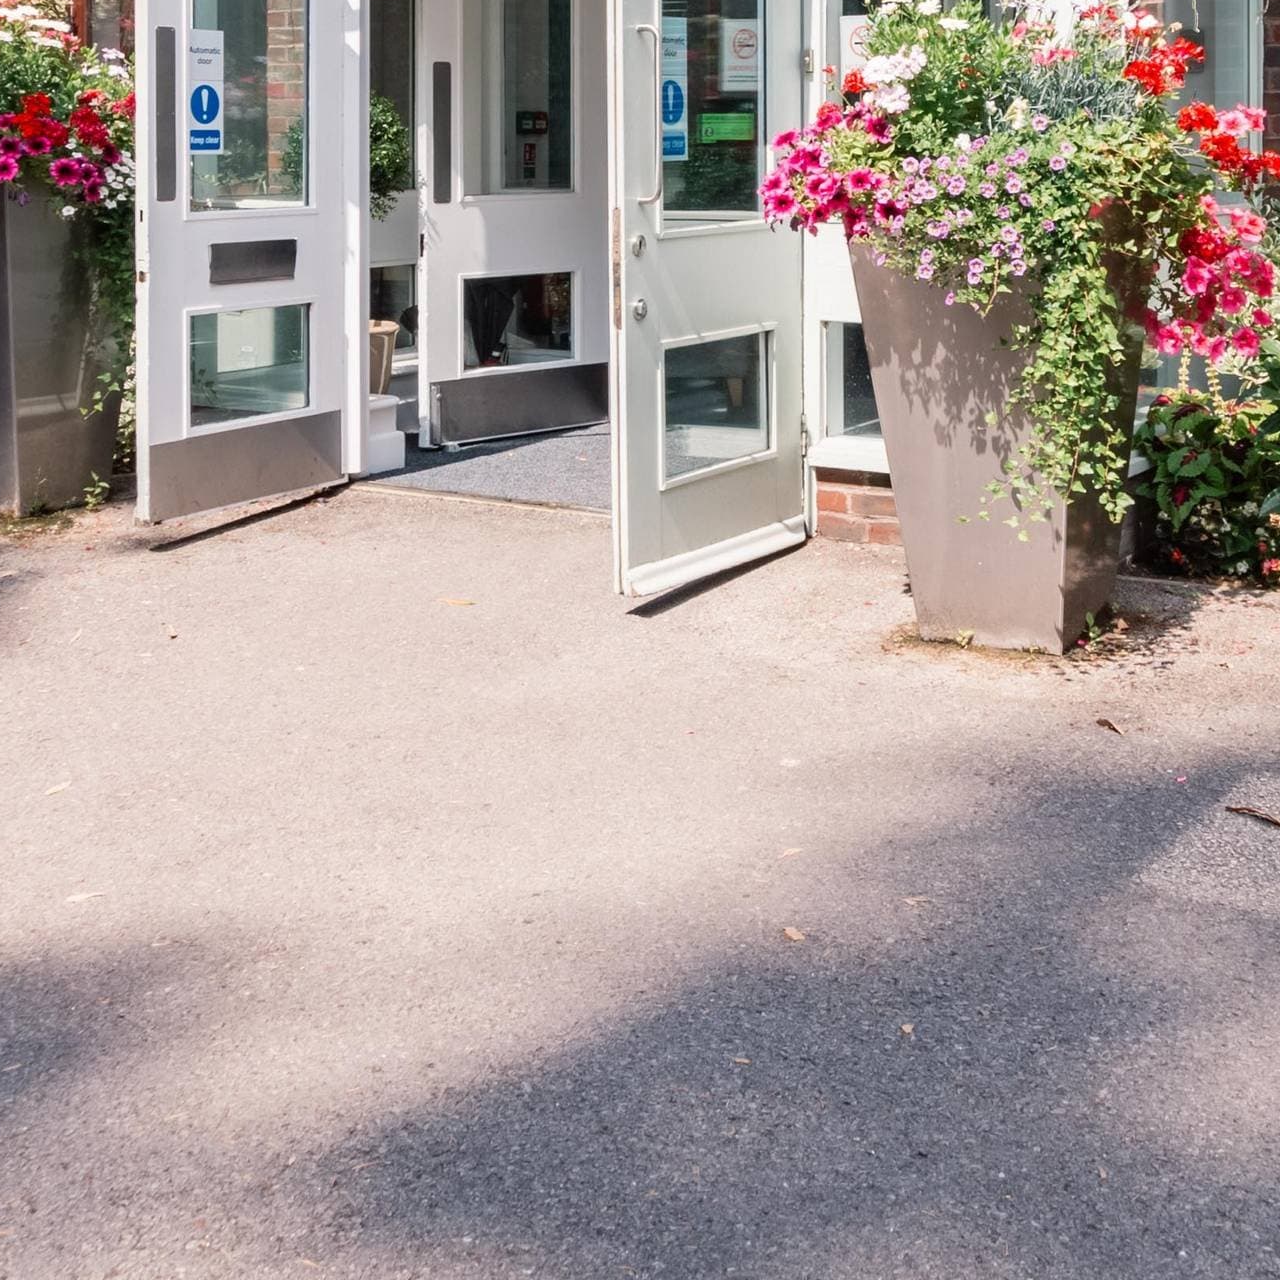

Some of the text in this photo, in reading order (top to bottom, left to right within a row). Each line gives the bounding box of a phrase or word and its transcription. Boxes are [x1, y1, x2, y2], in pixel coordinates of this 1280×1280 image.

[189, 45, 221, 55] Automatic
[191, 136, 219, 146] Keep clear
